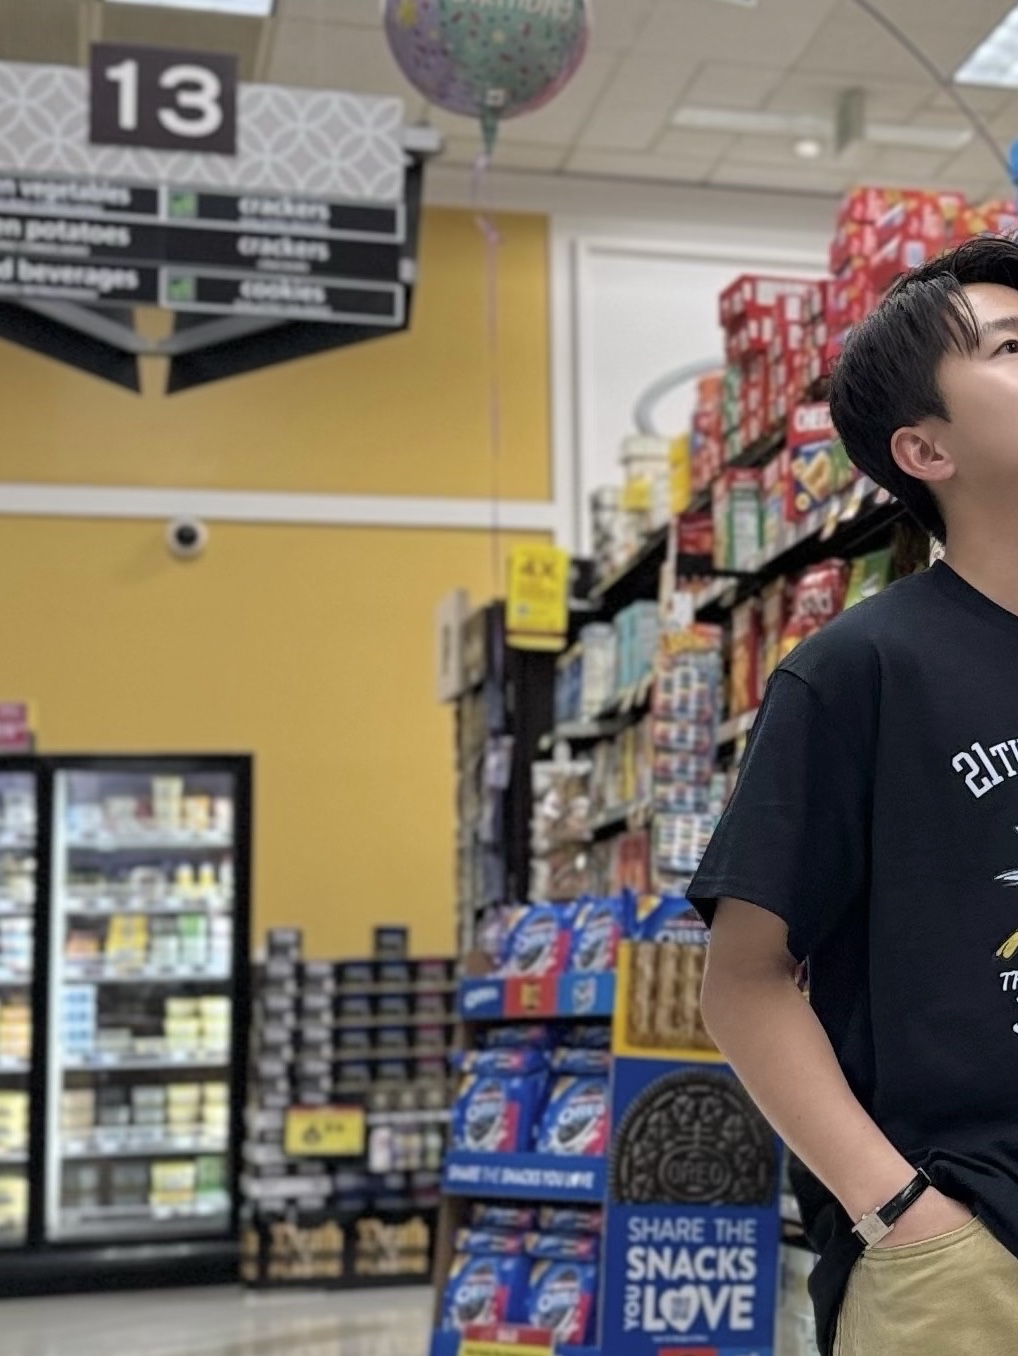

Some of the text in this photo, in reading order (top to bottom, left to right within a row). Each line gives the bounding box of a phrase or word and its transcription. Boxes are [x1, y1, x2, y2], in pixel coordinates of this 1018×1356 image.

[105, 60, 223, 137] 13
[25, 219, 131, 247] potatoes
[237, 235, 330, 262] crackers
[17, 257, 140, 293] beverages
[668, 1157, 723, 1186] OREO
[627, 1215, 757, 1244] SHARE THE
[626, 1246, 757, 1281] SNACKS
[623, 1284, 642, 1333] YOU
